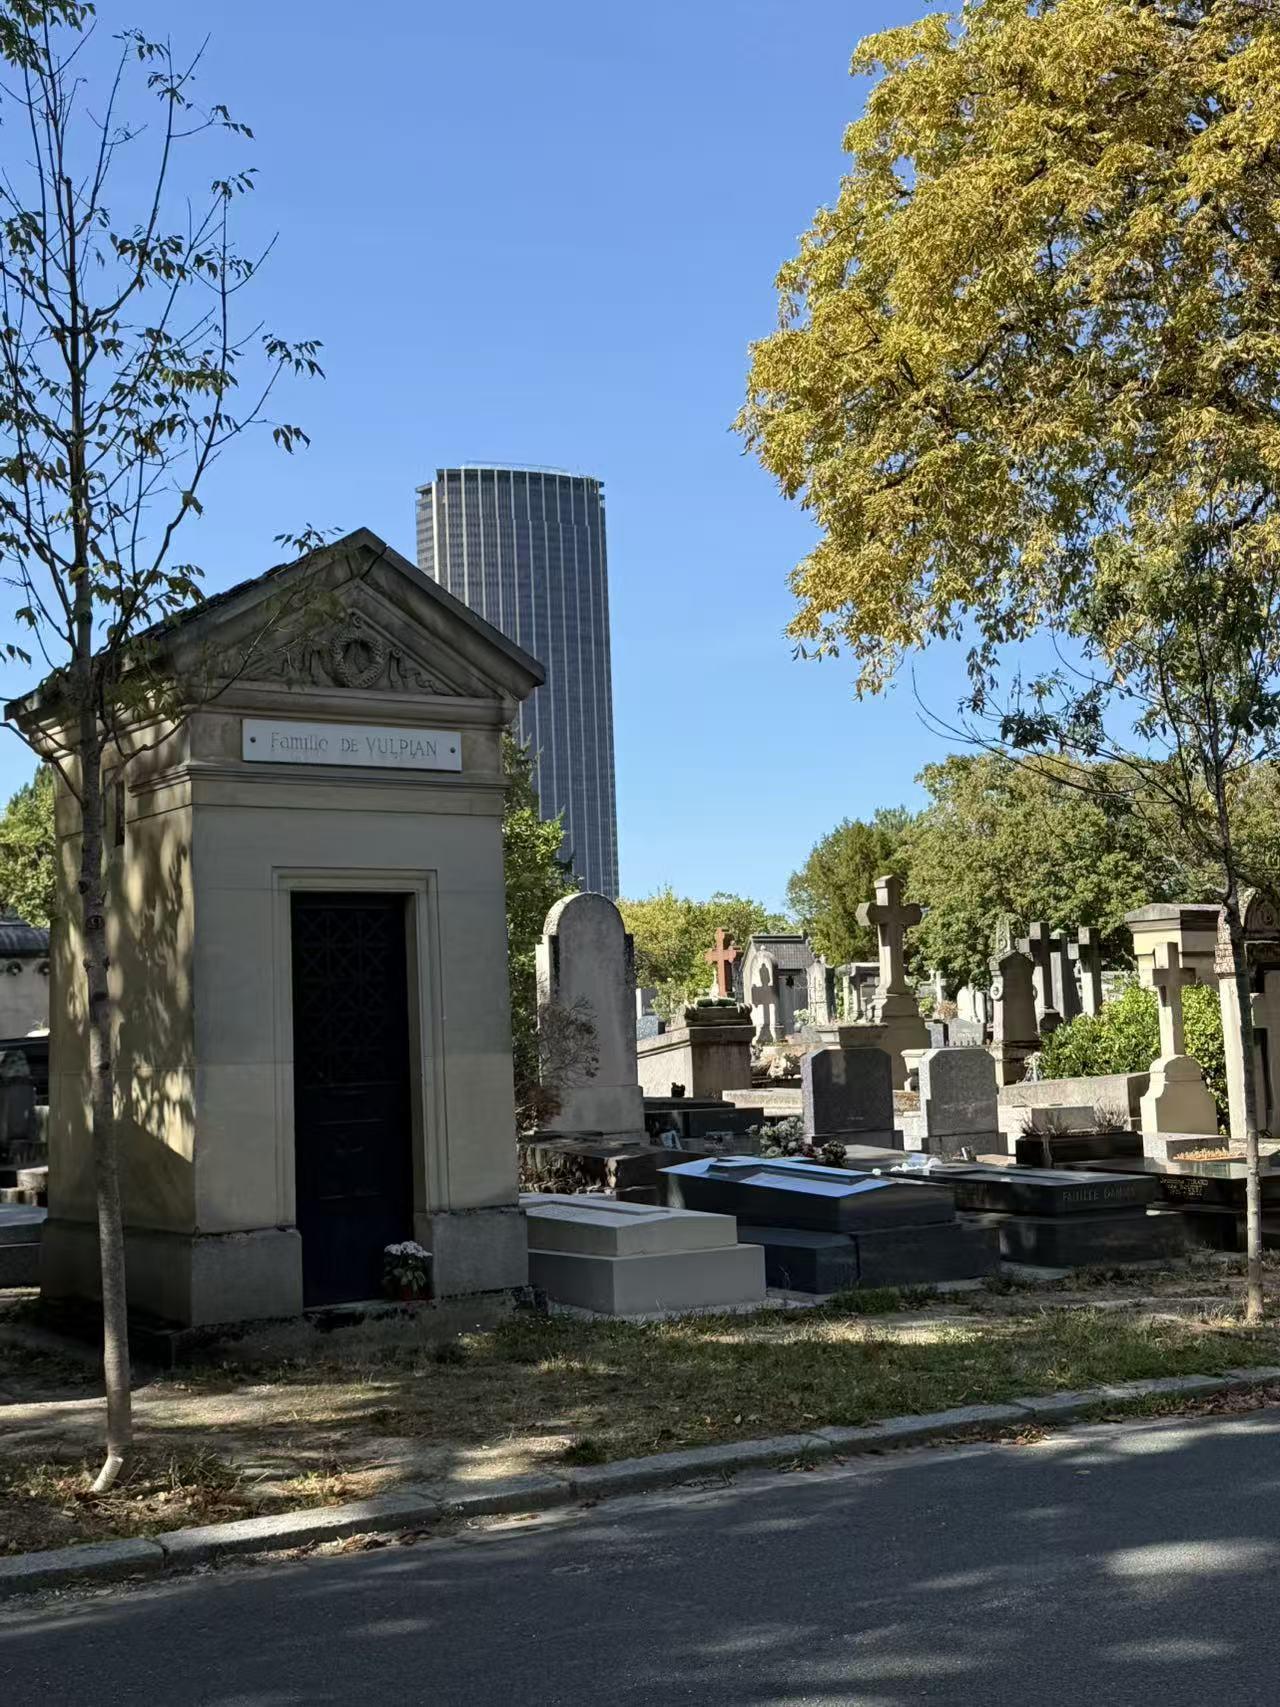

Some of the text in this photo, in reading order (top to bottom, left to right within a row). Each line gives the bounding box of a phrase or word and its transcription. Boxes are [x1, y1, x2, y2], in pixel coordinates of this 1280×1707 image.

[271, 732, 437, 757] Famille DE VULPIAN
